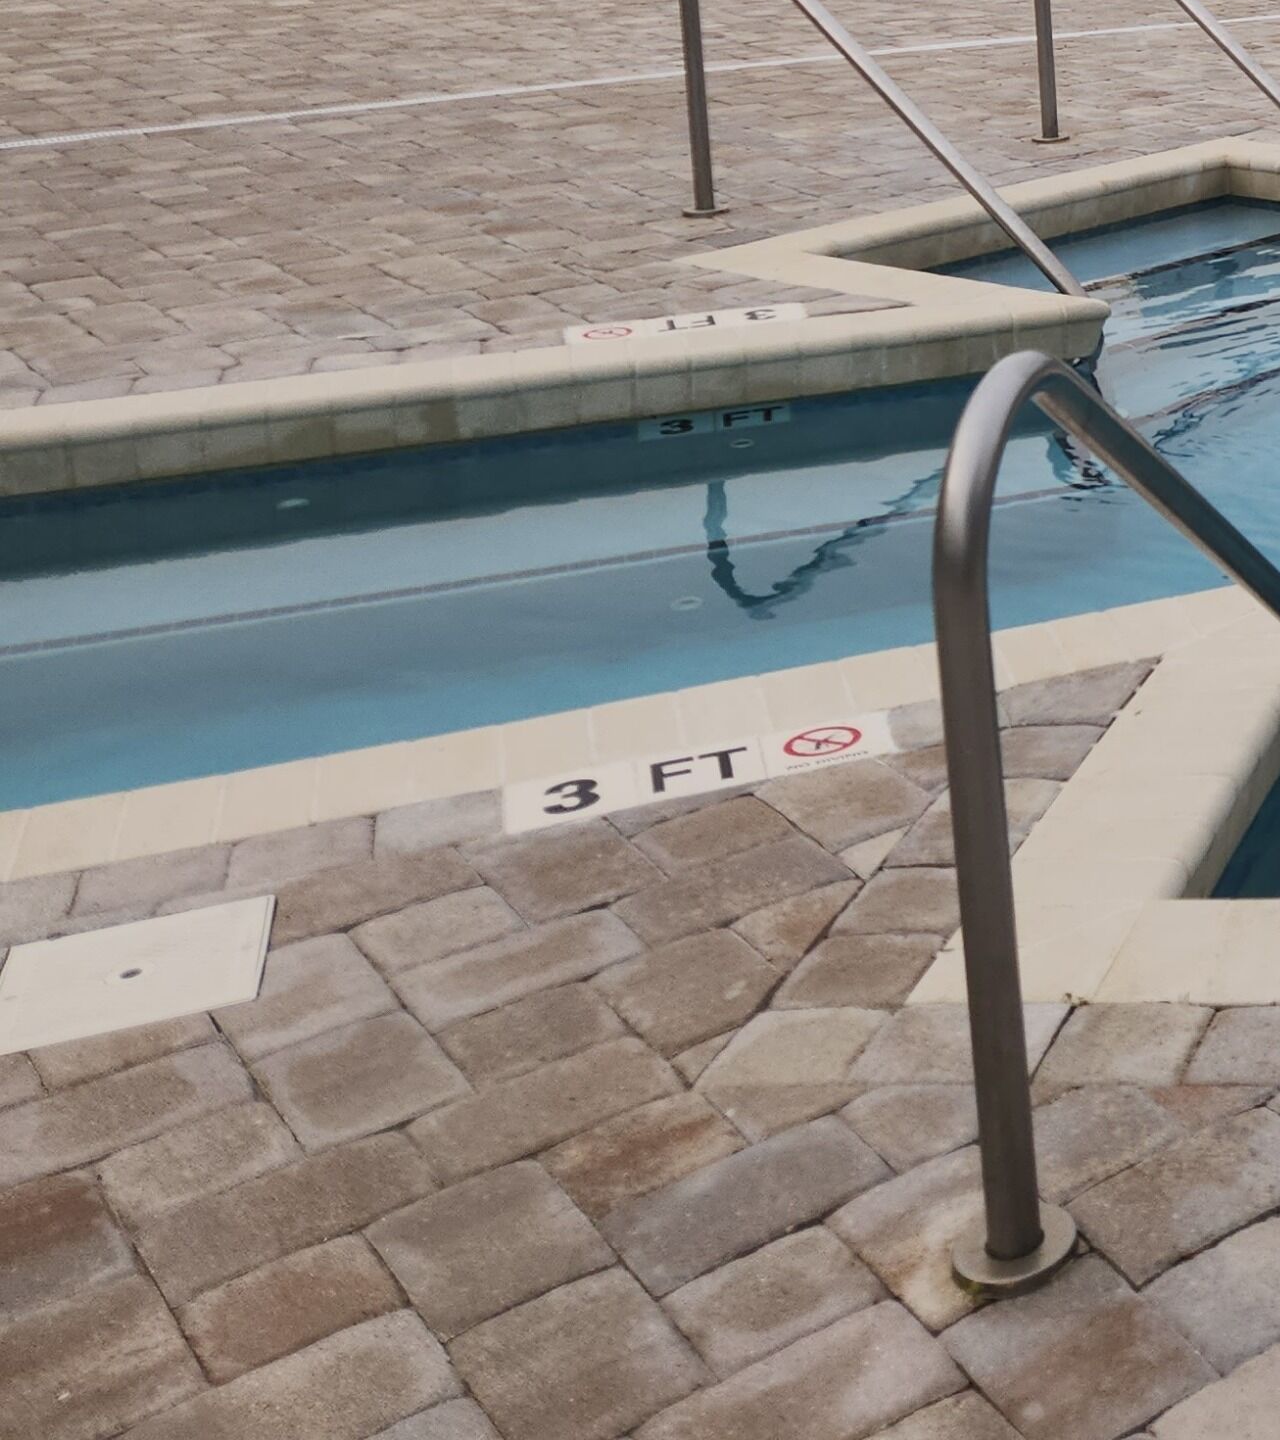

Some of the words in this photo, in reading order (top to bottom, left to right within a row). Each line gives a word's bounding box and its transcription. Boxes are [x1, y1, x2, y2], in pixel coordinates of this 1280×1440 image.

[658, 314, 715, 332] FT
[744, 308, 776, 321] 3
[659, 418, 694, 436] 3
[722, 405, 783, 428] FT
[542, 778, 601, 815] 3
[649, 746, 748, 794] FT
